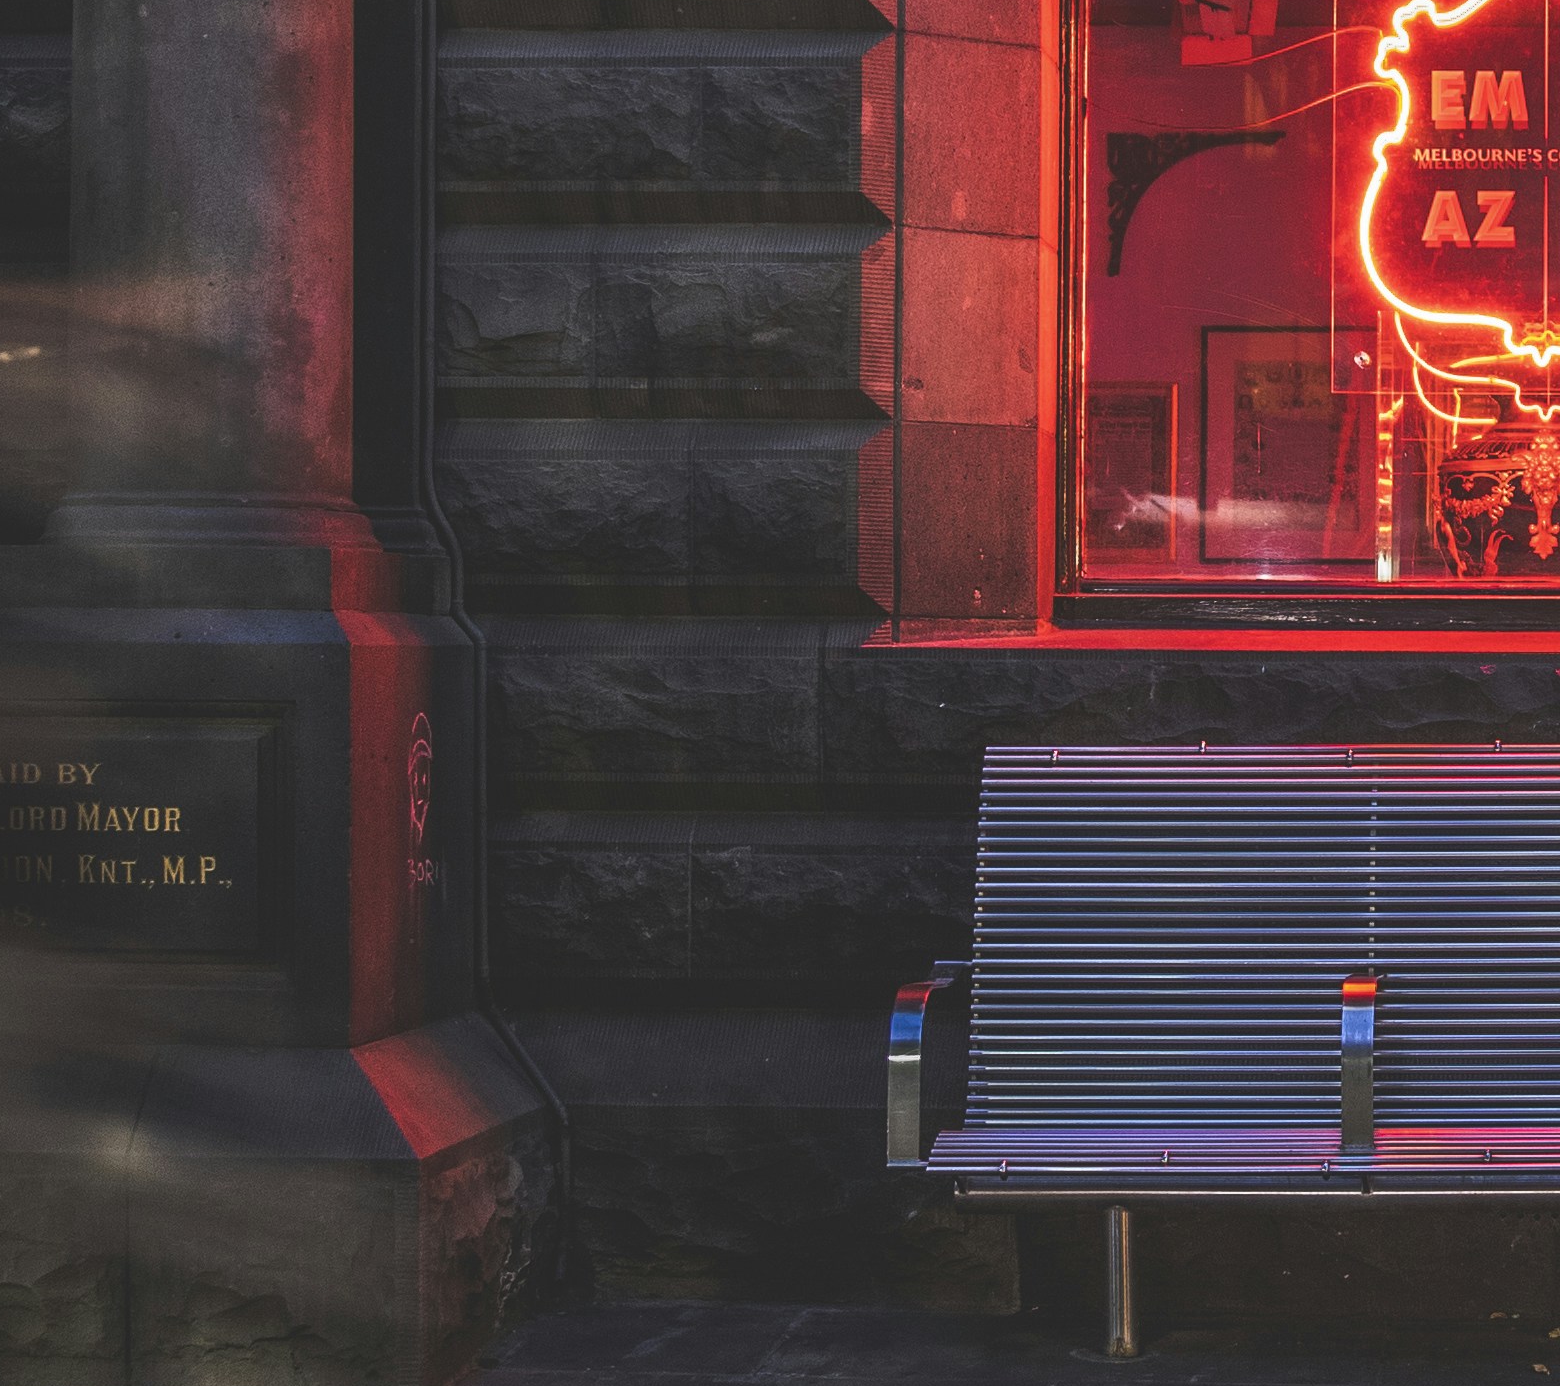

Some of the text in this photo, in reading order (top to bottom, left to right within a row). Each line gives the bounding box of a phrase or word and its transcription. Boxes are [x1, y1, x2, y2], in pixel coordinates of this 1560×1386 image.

[1431, 70, 1529, 124] EM
[1414, 148, 1542, 163] MELBOURNE'S
[1421, 190, 1516, 245] AZ
[57, 762, 104, 786] BY
